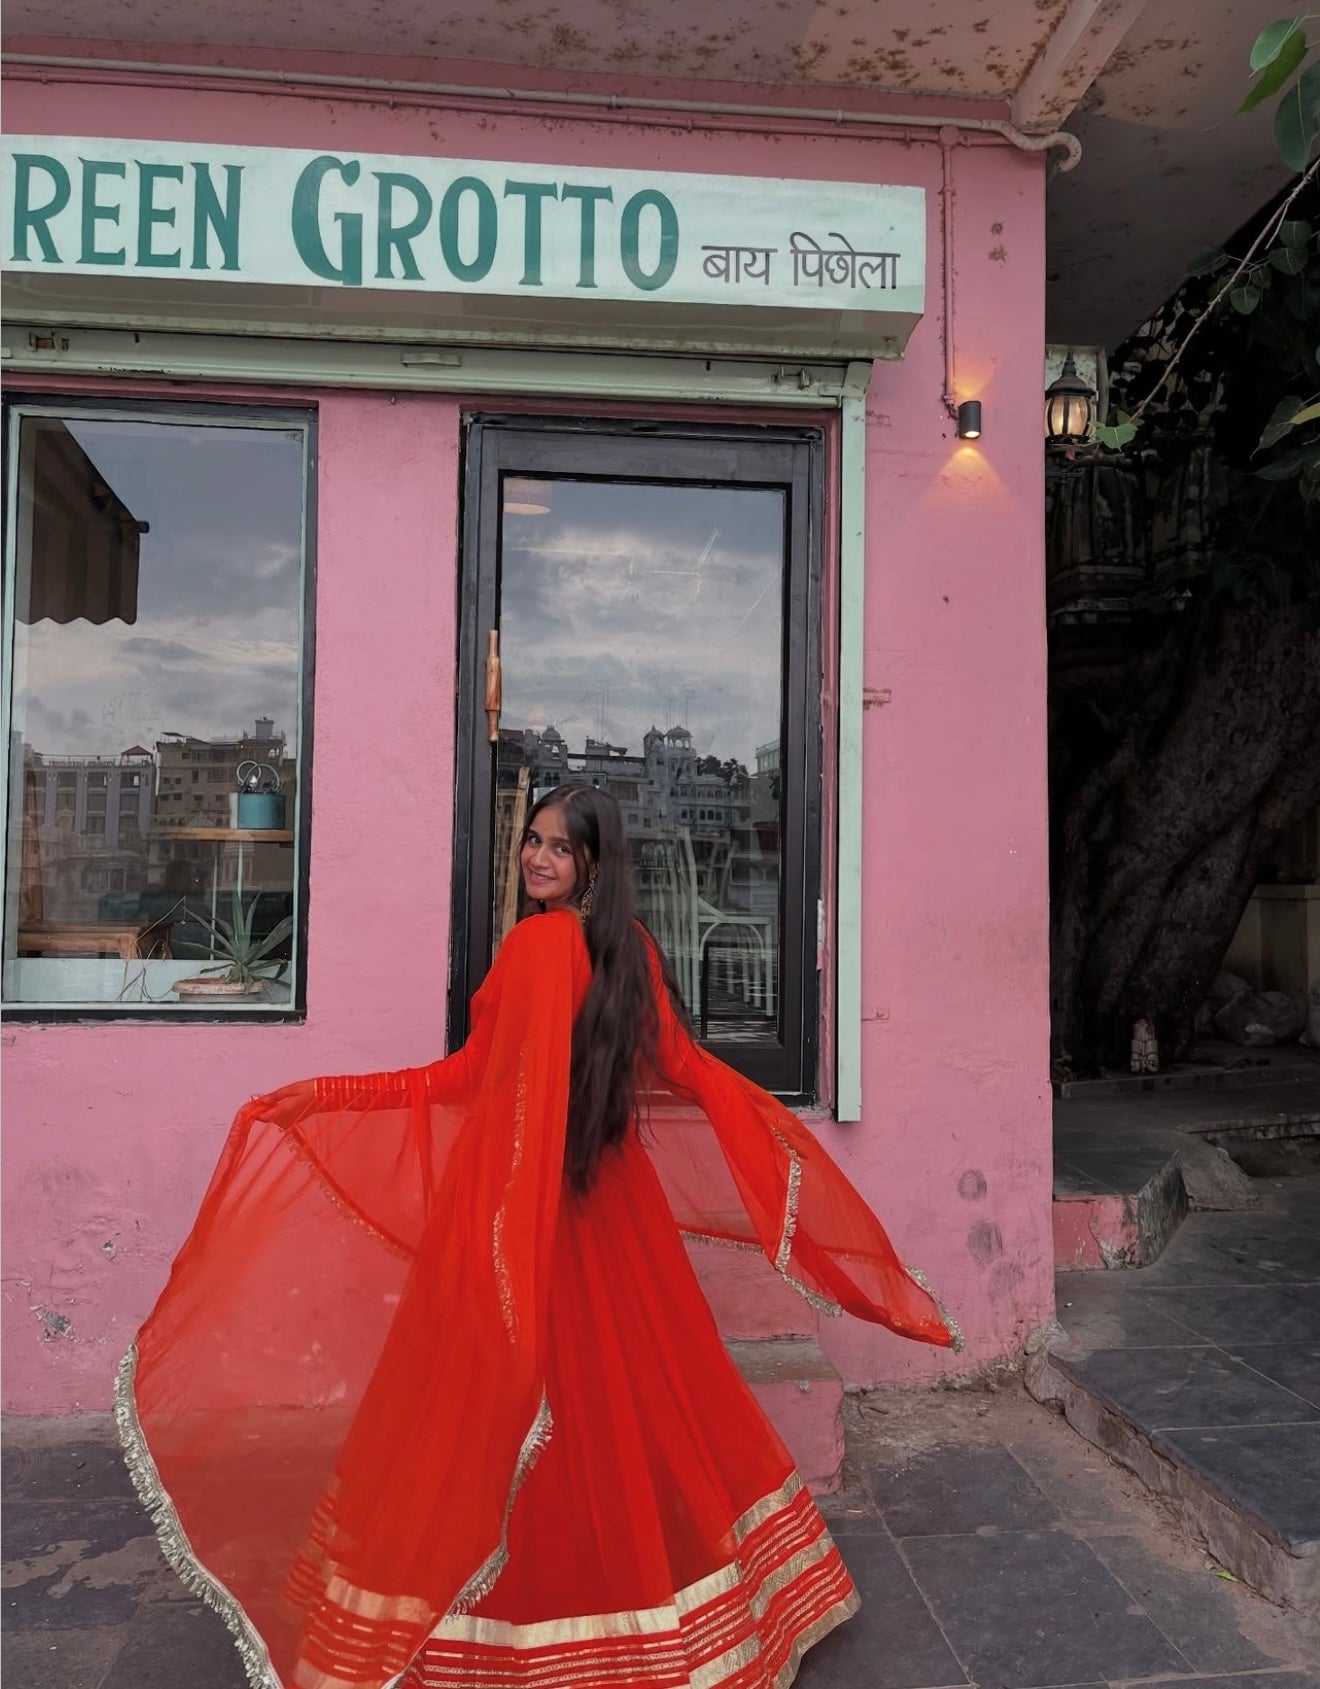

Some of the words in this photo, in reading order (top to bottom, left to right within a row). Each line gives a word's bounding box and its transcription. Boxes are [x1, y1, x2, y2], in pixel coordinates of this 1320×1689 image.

[291, 154, 680, 291] GROTTO
[701, 245, 778, 285] बाय
[789, 231, 901, 290] पिछोला
